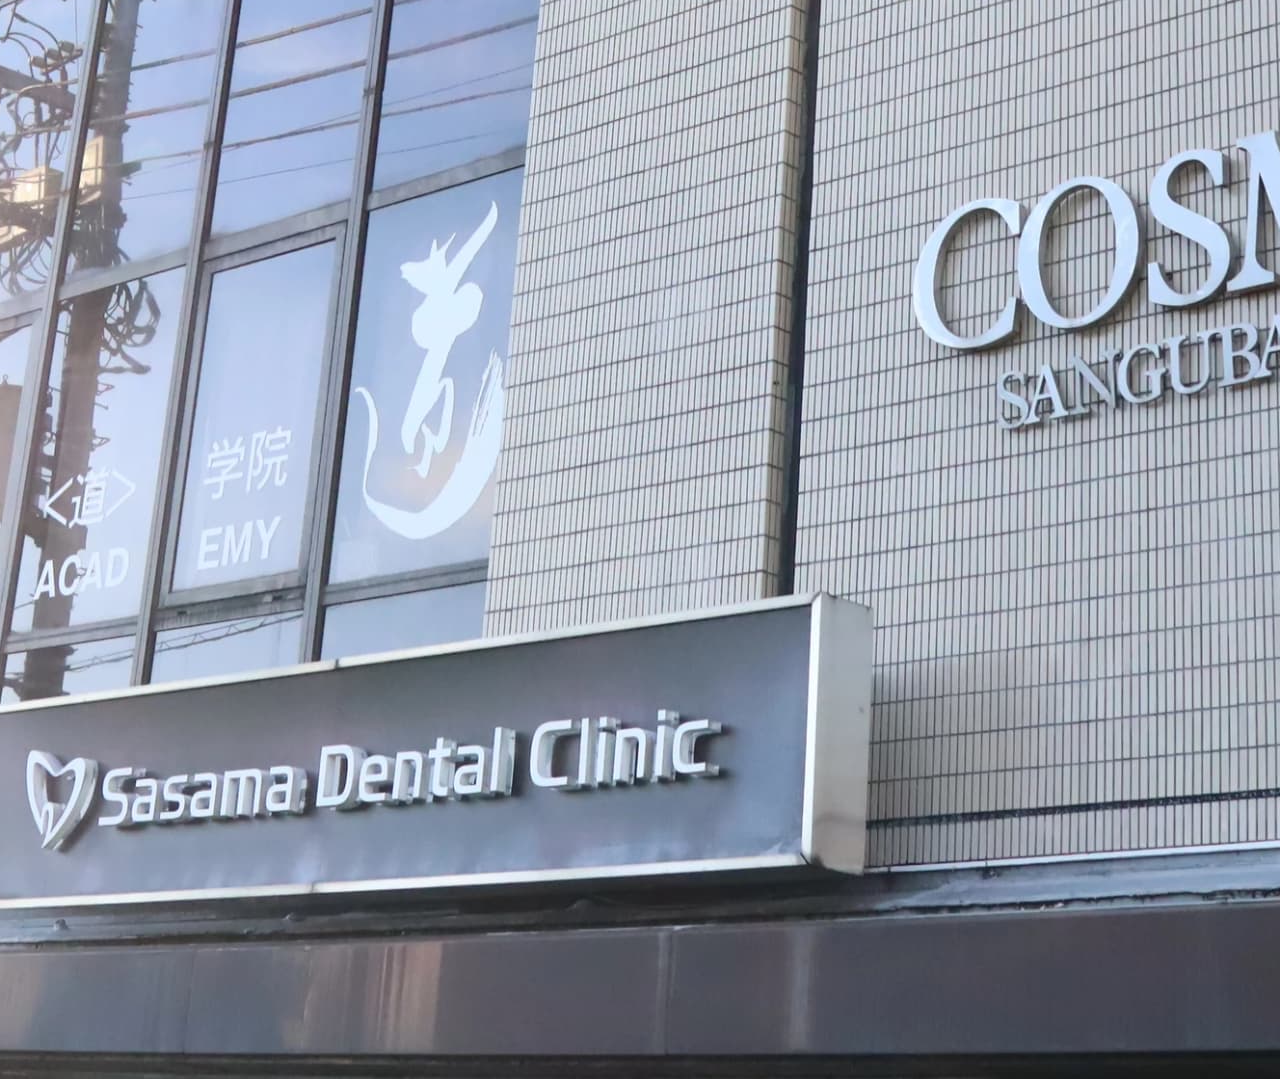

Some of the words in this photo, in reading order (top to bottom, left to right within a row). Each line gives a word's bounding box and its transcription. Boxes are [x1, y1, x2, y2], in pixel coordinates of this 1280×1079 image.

[203, 425, 293, 501] 学院
[33, 547, 130, 601] ACAD
[197, 516, 282, 571] EMY
[98, 764, 308, 828] Sasama
[317, 725, 517, 810] Dental
[530, 708, 724, 791] Clinic
